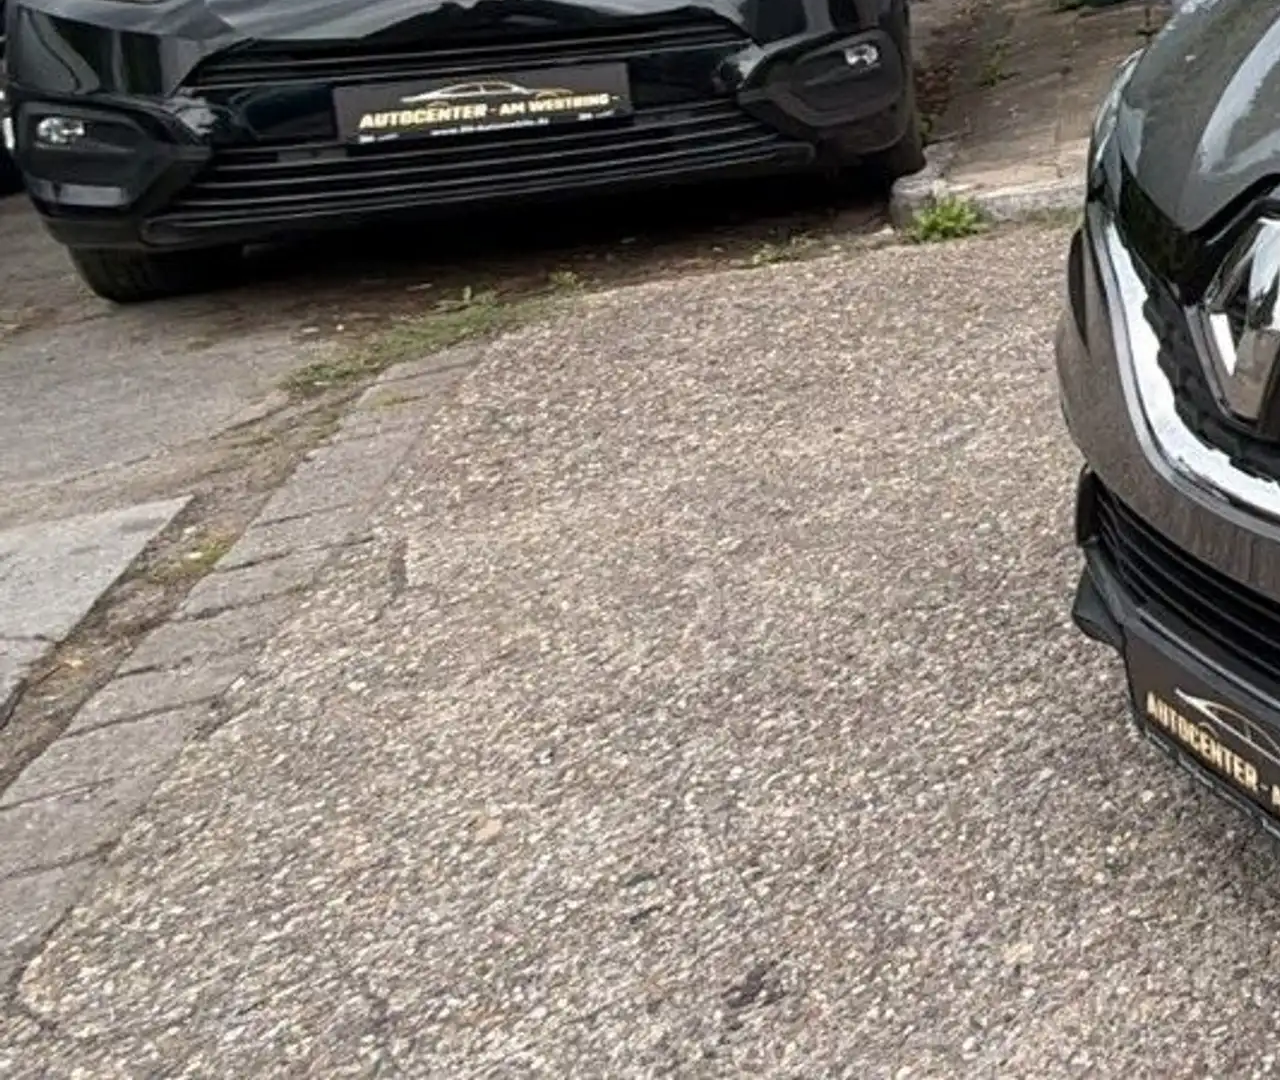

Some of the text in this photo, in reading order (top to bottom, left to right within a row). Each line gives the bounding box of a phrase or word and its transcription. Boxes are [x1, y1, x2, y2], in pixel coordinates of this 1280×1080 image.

[358, 102, 488, 129] AUTOCENTER
[499, 101, 526, 116] AM
[1146, 689, 1258, 793] AUTOCENTER
